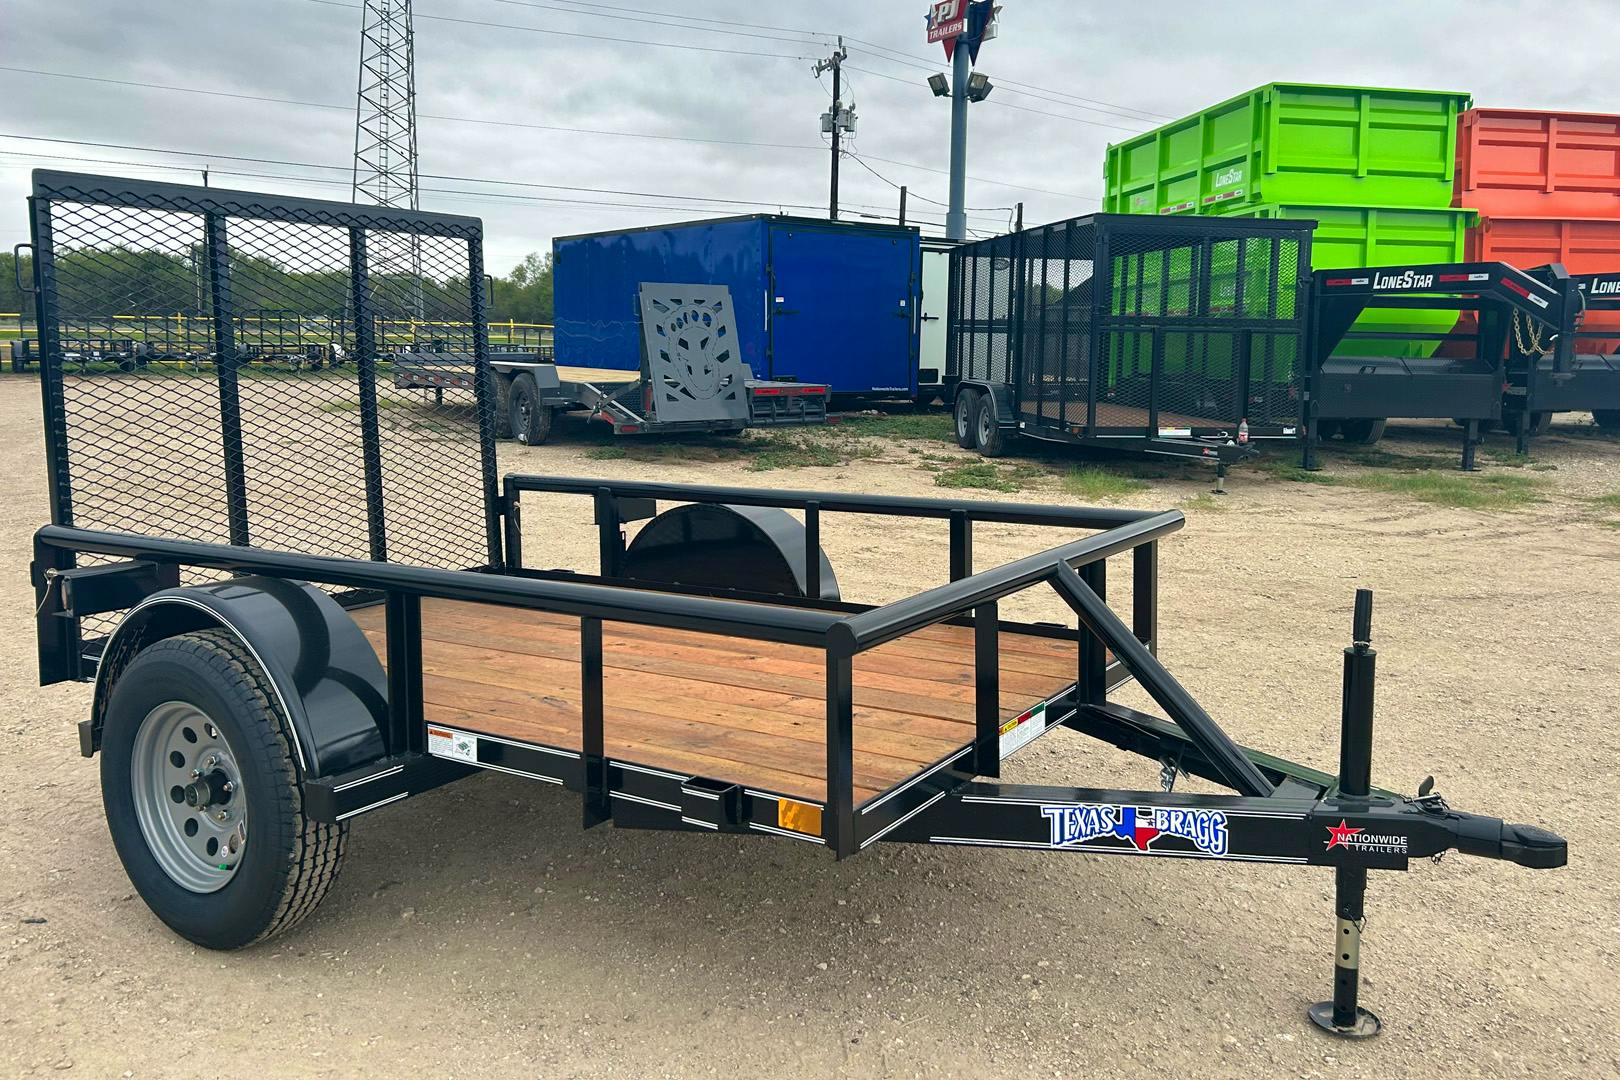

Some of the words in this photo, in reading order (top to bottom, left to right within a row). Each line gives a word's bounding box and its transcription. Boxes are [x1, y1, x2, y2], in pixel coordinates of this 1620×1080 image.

[929, 22, 963, 40] TRAILERS
[1041, 805, 1117, 848] TEXAS
[1154, 808, 1229, 857] BRAGG
[1337, 832, 1408, 846] NATIONWIDE
[1355, 844, 1408, 855] TRAILERS
